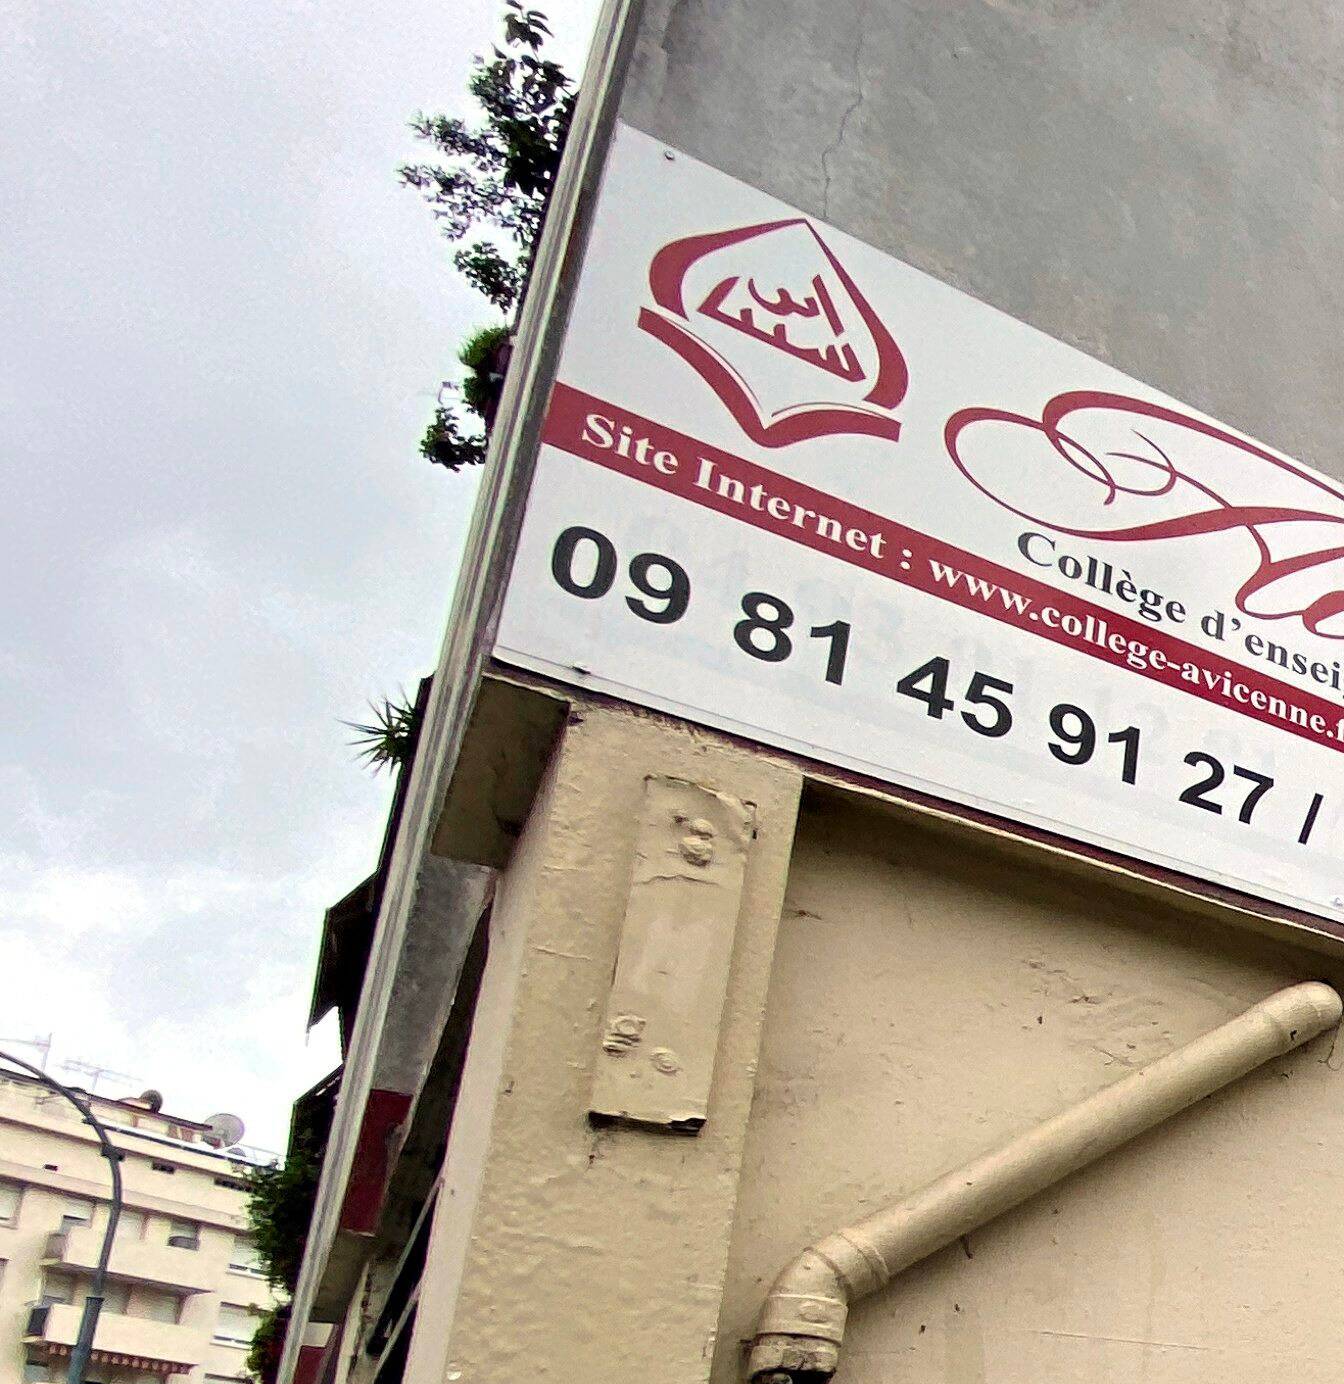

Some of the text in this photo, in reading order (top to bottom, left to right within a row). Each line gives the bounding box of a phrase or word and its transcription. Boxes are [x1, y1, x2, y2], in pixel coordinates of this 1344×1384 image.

[581, 412, 679, 476] Site
[692, 456, 888, 560] Internet
[1016, 530, 1186, 623] Collège
[551, 525, 691, 625] 09
[733, 591, 852, 686] 81
[896, 656, 1014, 738] 45
[1047, 703, 1141, 786] 91
[1178, 751, 1275, 825] 27
